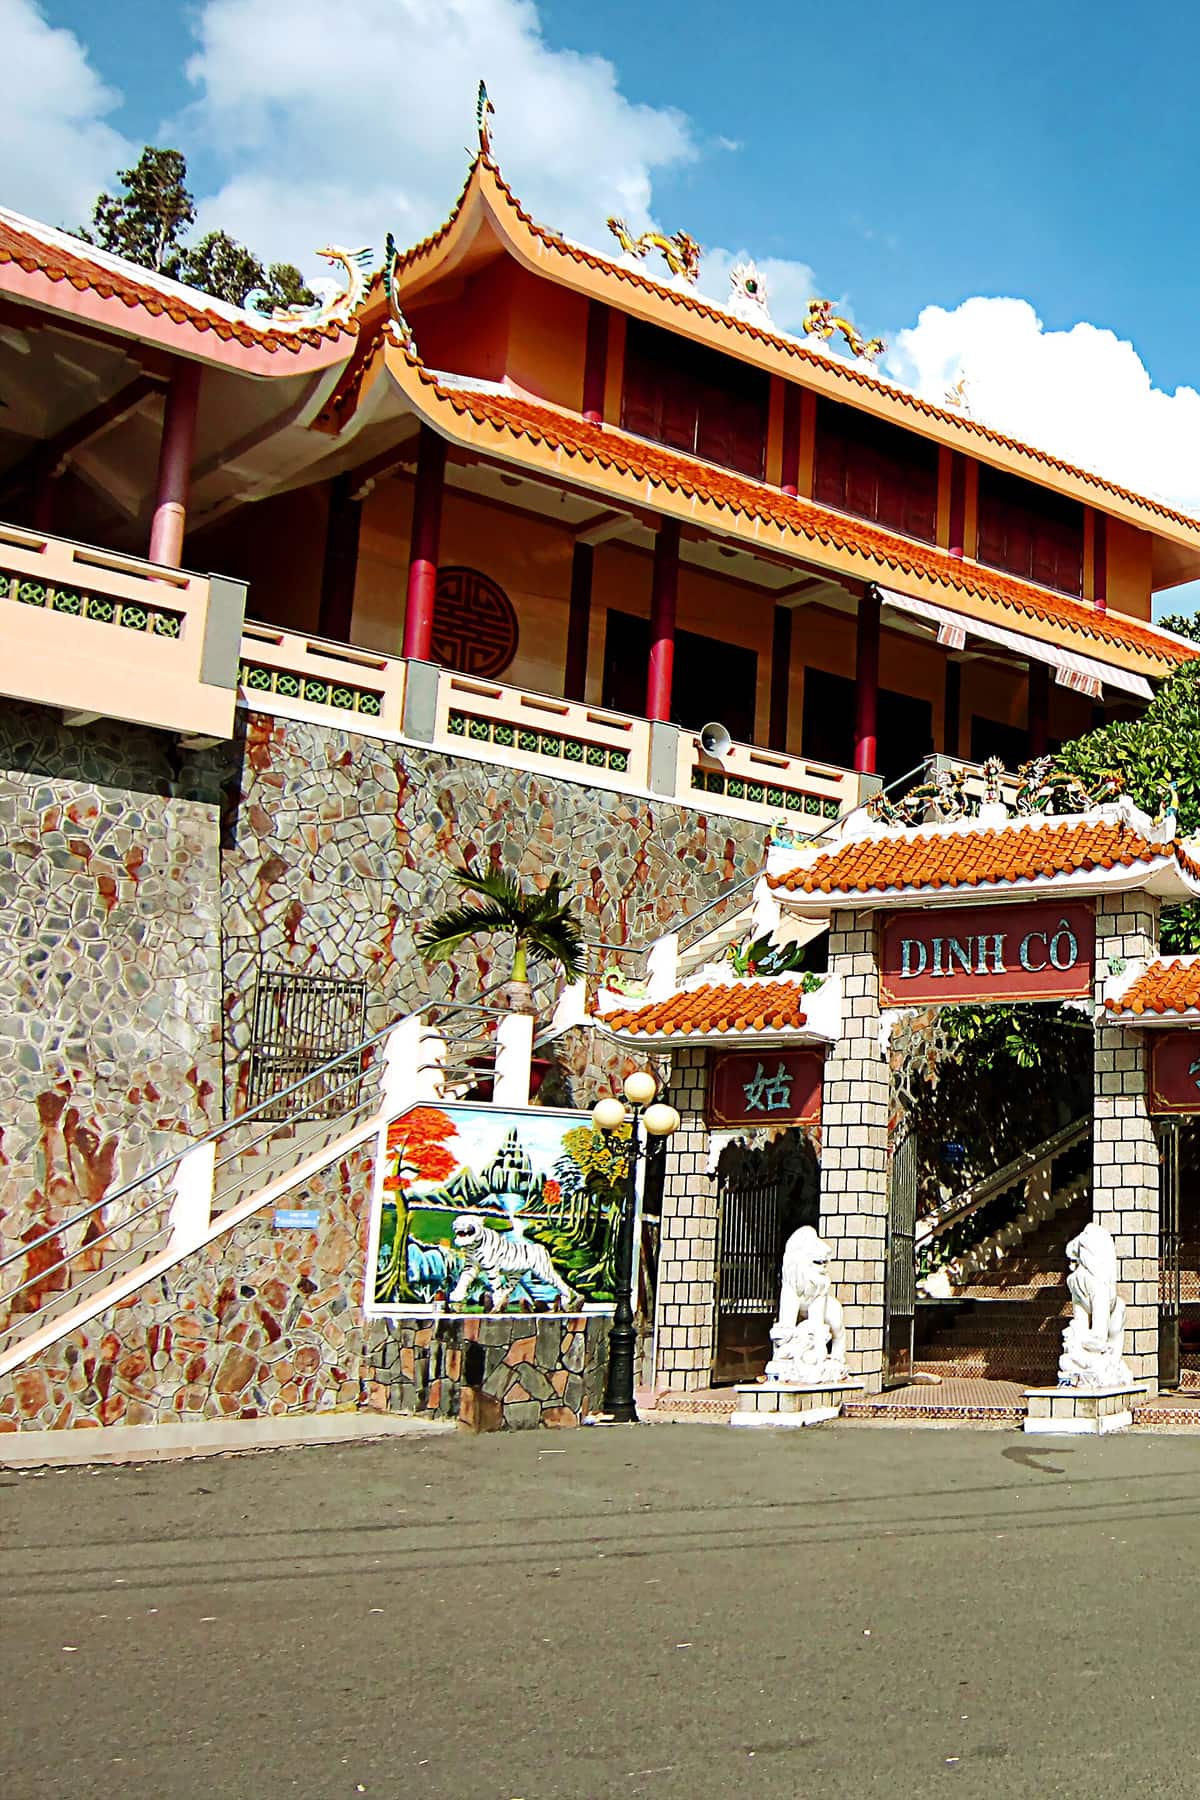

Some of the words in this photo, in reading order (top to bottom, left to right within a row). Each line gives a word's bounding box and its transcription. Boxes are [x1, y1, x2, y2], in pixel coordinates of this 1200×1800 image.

[899, 934, 1007, 978] DINH
[1020, 919, 1078, 972] CÔ
[742, 1062, 794, 1112] 姑
